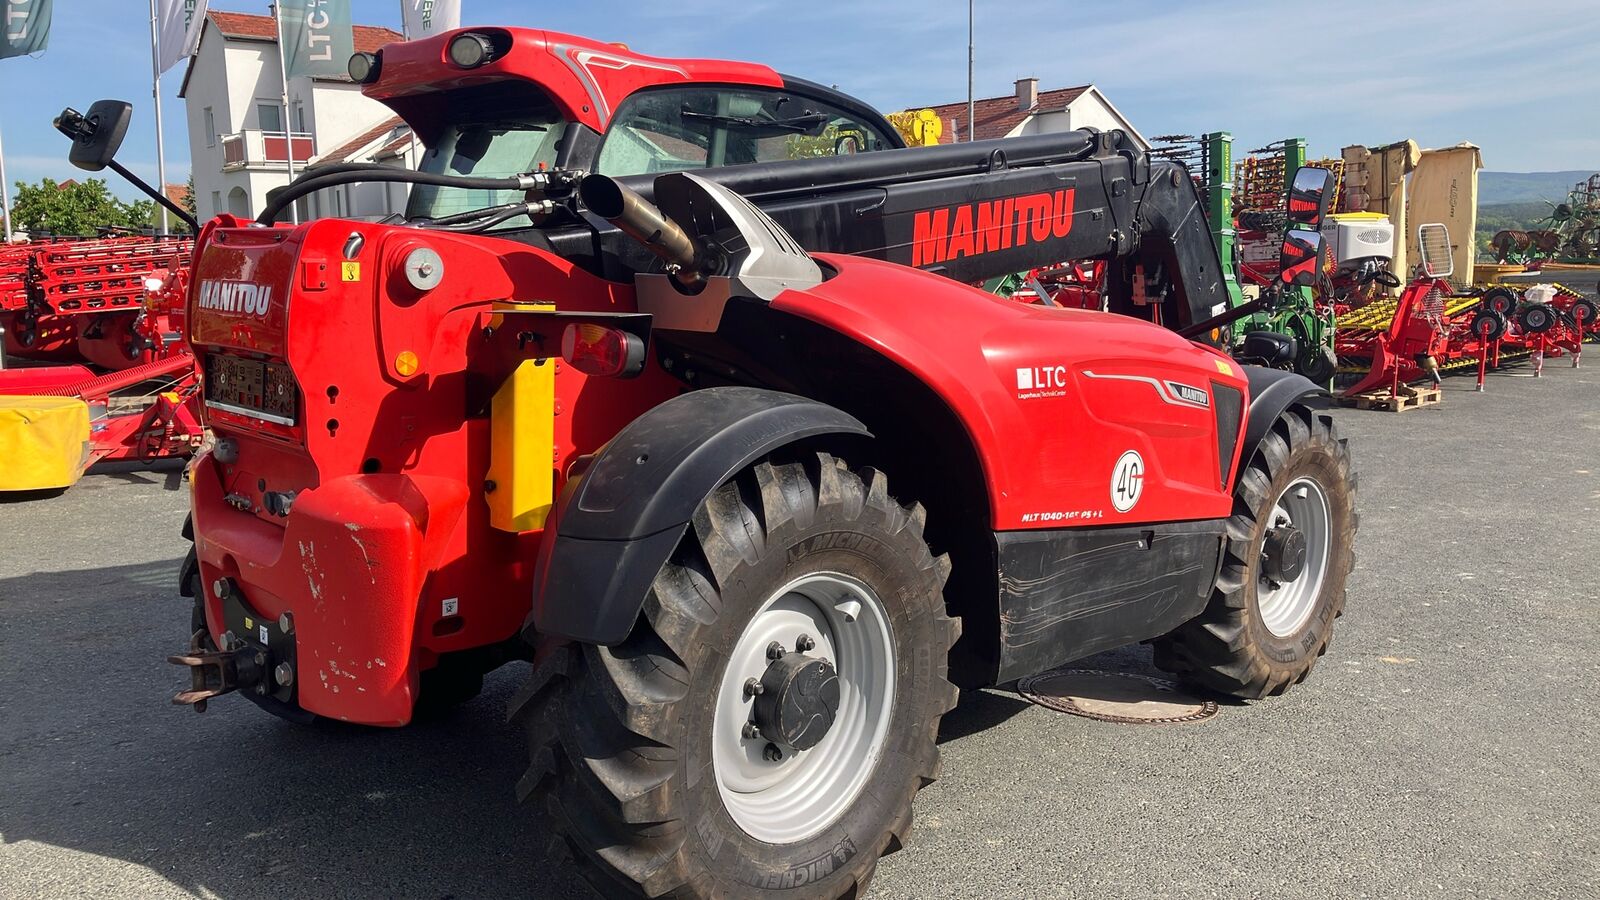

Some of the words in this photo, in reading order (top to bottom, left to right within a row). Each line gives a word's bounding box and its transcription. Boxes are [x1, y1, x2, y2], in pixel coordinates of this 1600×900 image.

[7, 0, 29, 40] LT
[307, 10, 332, 61] LTC
[911, 188, 1075, 268] MANITOU
[199, 280, 272, 315] MANITOU
[1034, 365, 1066, 389] LTC
[1181, 387, 1207, 404] MANITOU
[1117, 462, 1138, 501] 40
[1021, 512, 1039, 523] MLT
